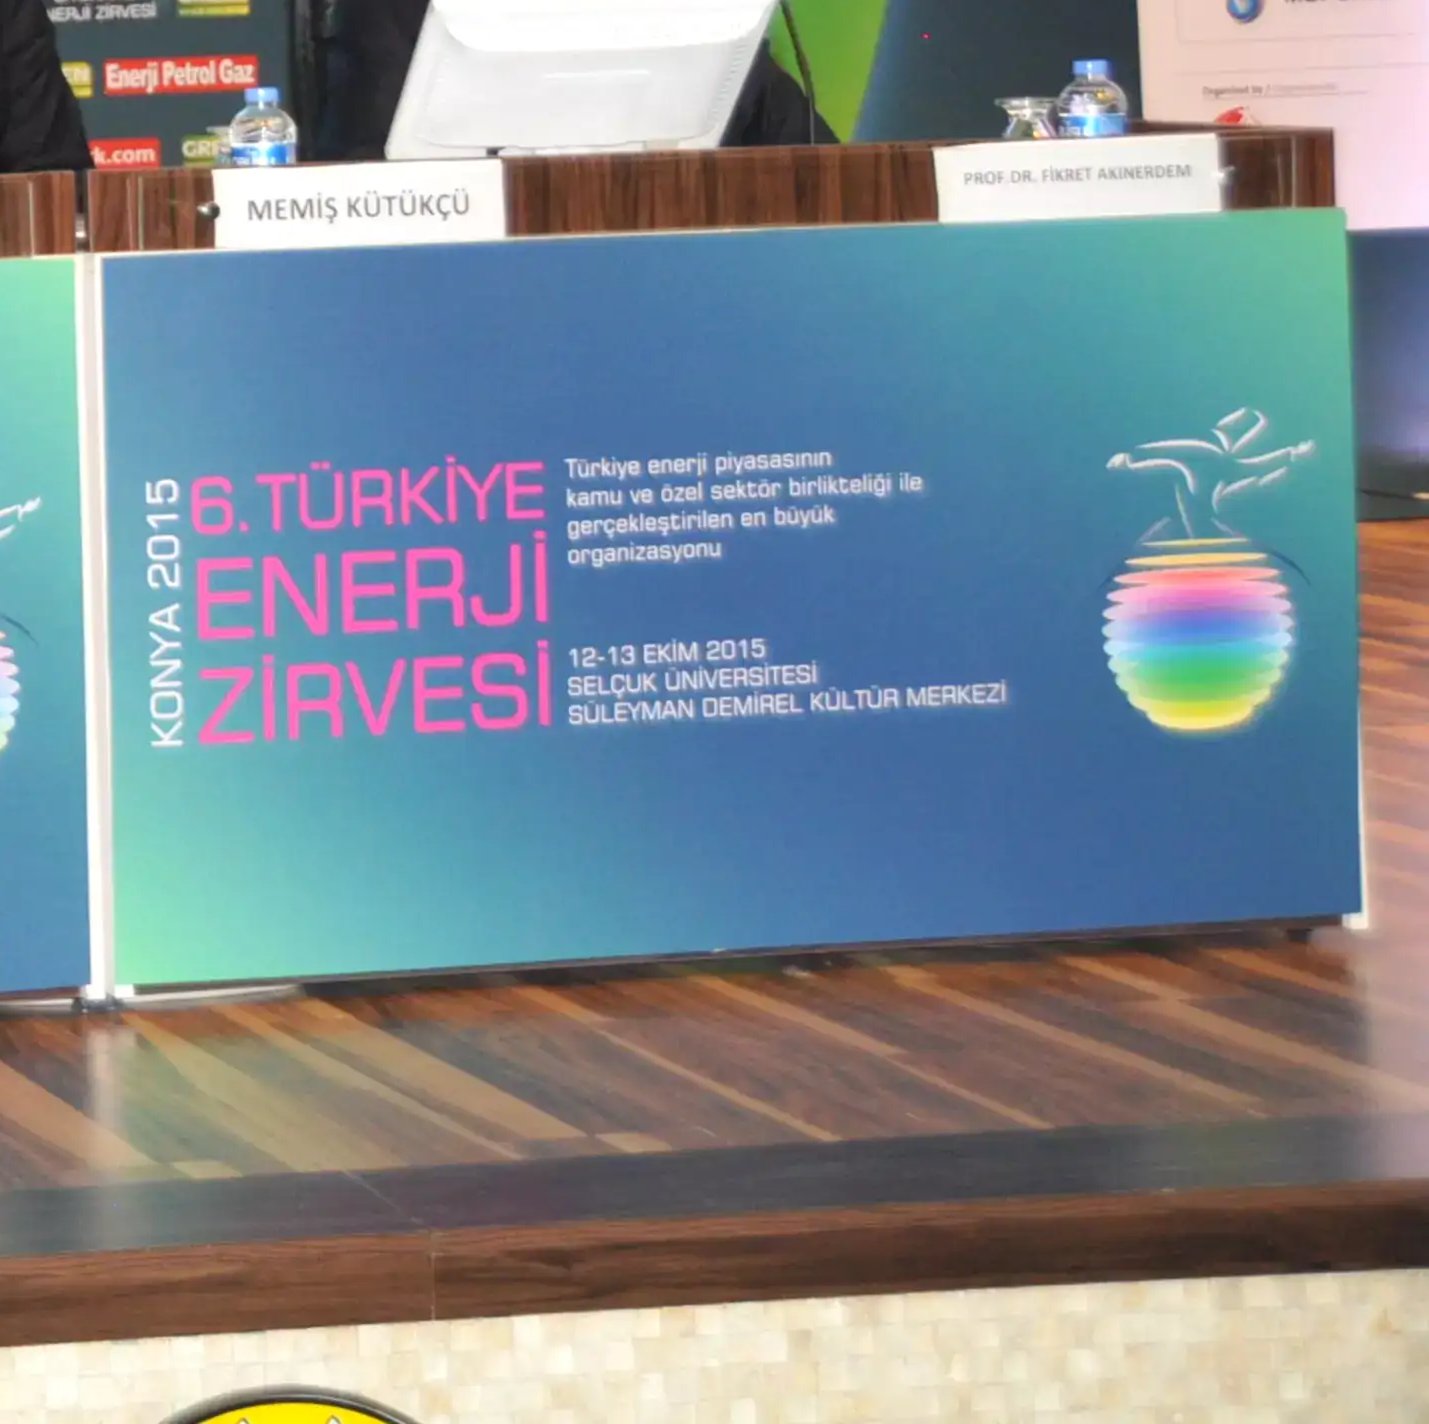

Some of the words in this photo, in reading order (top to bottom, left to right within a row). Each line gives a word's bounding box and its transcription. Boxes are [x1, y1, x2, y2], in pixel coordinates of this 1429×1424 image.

[46, 4, 91, 22] NERJİ
[96, 1, 156, 20] ZİRVESİ
[105, 61, 160, 93] Enerji
[163, 59, 215, 86] Petrol
[219, 58, 254, 84] Gaz
[1042, 164, 1091, 184] FİKRET
[1098, 164, 1192, 181] AKINERDEM
[247, 193, 338, 224] MEMİŞ
[347, 189, 470, 218] KÜTÜKÇÜ
[564, 458, 641, 480] Türkiye
[648, 452, 708, 476] enerji
[715, 450, 833, 474] piyasasının
[565, 488, 623, 508] kamu
[630, 488, 653, 503] ve
[661, 482, 703, 502] özel
[711, 479, 782, 500] sektör
[789, 472, 893, 496] birlikteliği
[899, 472, 923, 491] ile
[145, 478, 180, 589] 2015
[566, 511, 733, 540] gerçekleştirilen
[741, 509, 767, 526] en
[774, 504, 836, 528] büyük
[567, 540, 722, 568] organizasyonu
[196, 530, 549, 640] ENERJİ
[568, 645, 636, 668] 12-13
[643, 638, 699, 663] EKİM
[706, 638, 767, 660] 2015
[149, 603, 184, 747] KONYA
[198, 640, 551, 744] ZİRVESİ
[567, 668, 659, 697] SELÇUK
[665, 659, 818, 690] ÜNİVERSİTESİ
[568, 698, 694, 726] SÜLEYMAN
[702, 690, 803, 717] DEMİREL
[810, 684, 900, 711] KÜLTÜR
[906, 679, 1008, 707] MERKEZİ
